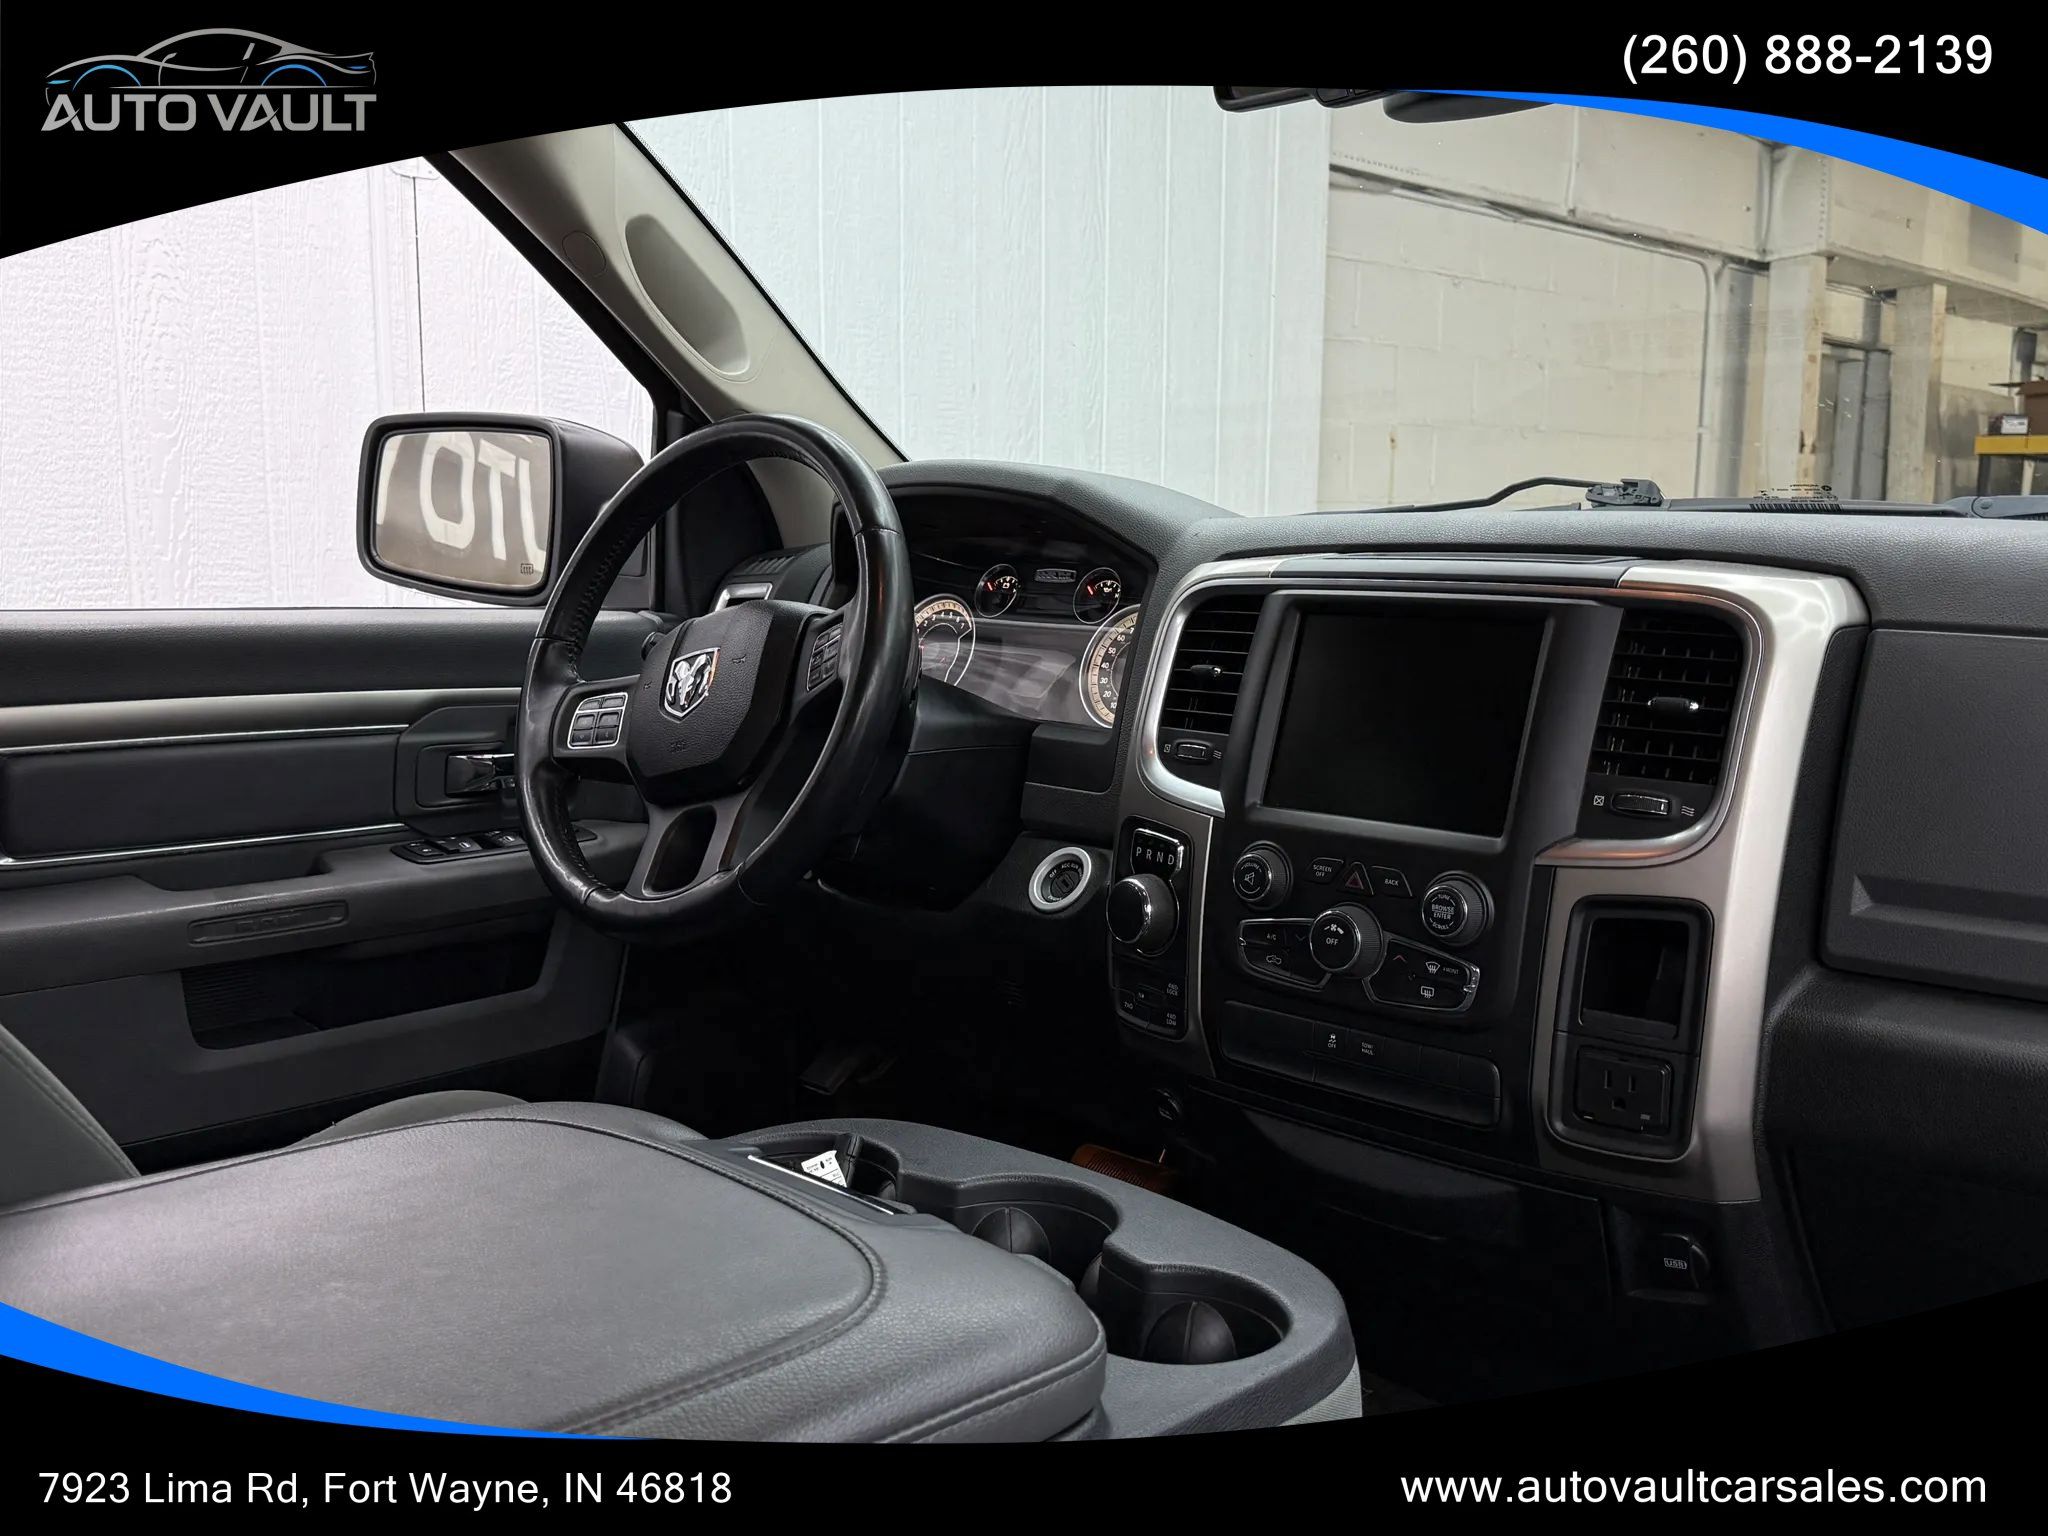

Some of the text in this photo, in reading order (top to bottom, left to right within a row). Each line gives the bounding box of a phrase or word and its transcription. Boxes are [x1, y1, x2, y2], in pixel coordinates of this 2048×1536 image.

[1116, 634, 1126, 642] 60
[1107, 646, 1117, 654] 50
[1100, 661, 1110, 669] 40
[1102, 690, 1112, 698] 20
[1135, 846, 1175, 865] P R N D
[1313, 864, 1332, 873] SCREEN
[1384, 878, 1399, 886] BACK
[1431, 903, 1455, 912] BROWSE
[1433, 912, 1452, 920] ENTER
[1266, 933, 1277, 941] A/C
[1325, 937, 1339, 946] OFF
